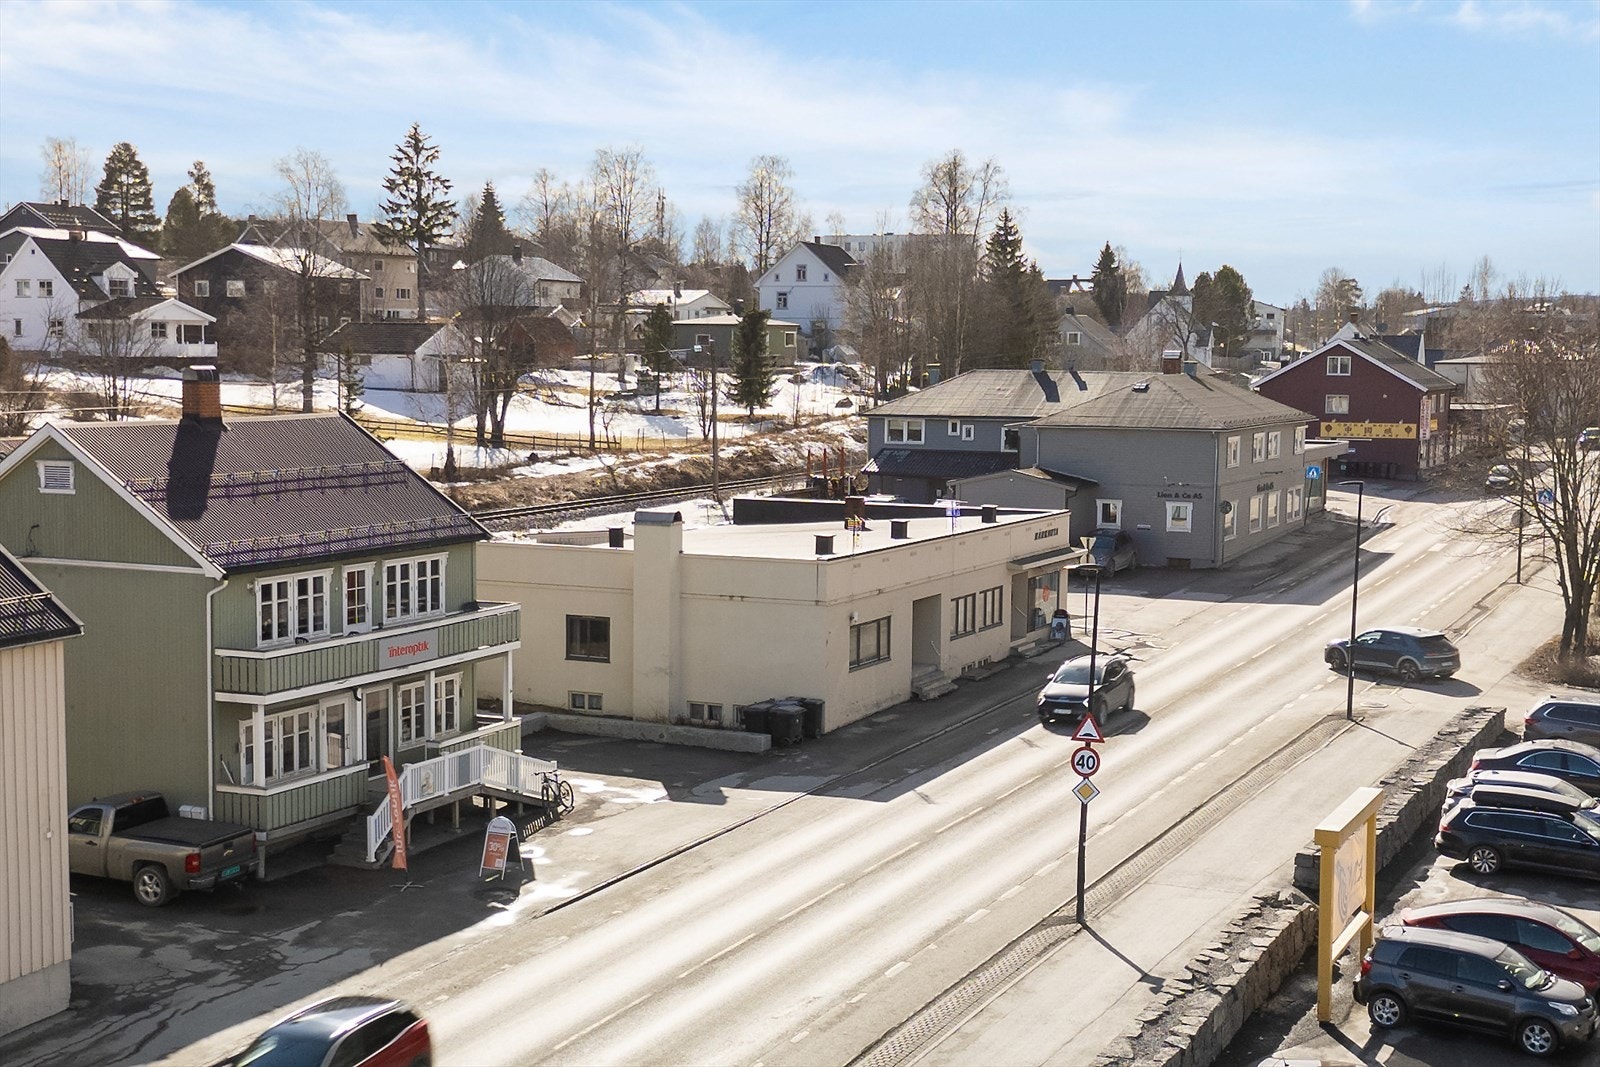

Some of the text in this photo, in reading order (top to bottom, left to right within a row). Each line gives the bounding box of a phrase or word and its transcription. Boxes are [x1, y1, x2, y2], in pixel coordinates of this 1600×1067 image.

[388, 641, 428, 657] interoptik
[1076, 754, 1096, 770] 40
[488, 840, 505, 852] 30%
